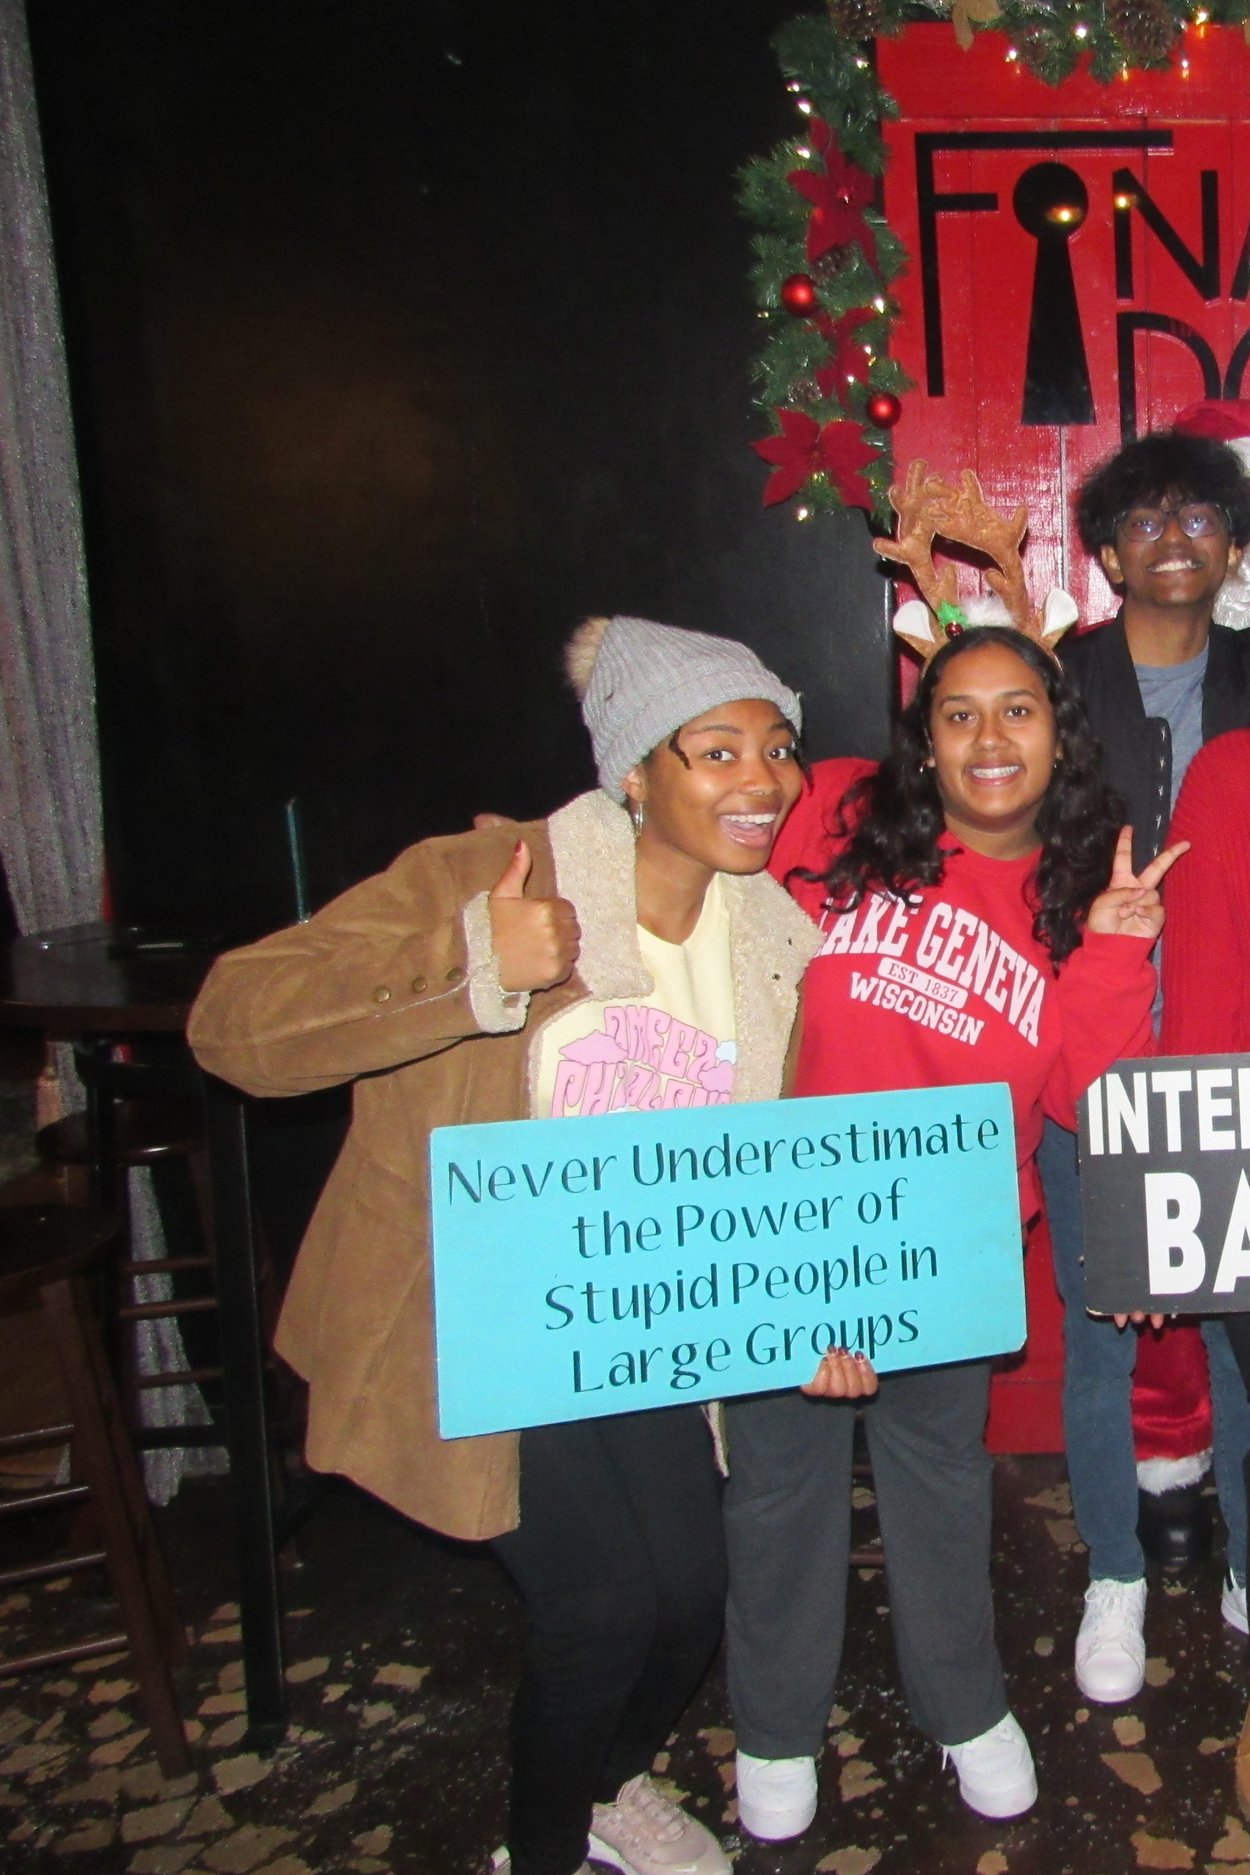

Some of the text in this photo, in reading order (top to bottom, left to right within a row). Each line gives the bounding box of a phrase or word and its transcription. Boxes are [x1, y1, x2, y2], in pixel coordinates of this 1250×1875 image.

[814, 889, 1046, 1048] AKE GENEVA
[849, 971, 985, 1046] WISCONSIN
[887, 963, 959, 1004] EST 1837
[446, 1112, 1001, 1206] Never Underestimate
[572, 1176, 909, 1259] the Power of
[545, 1240, 938, 1330] Stupid People in
[572, 1307, 920, 1394] Large Groups
